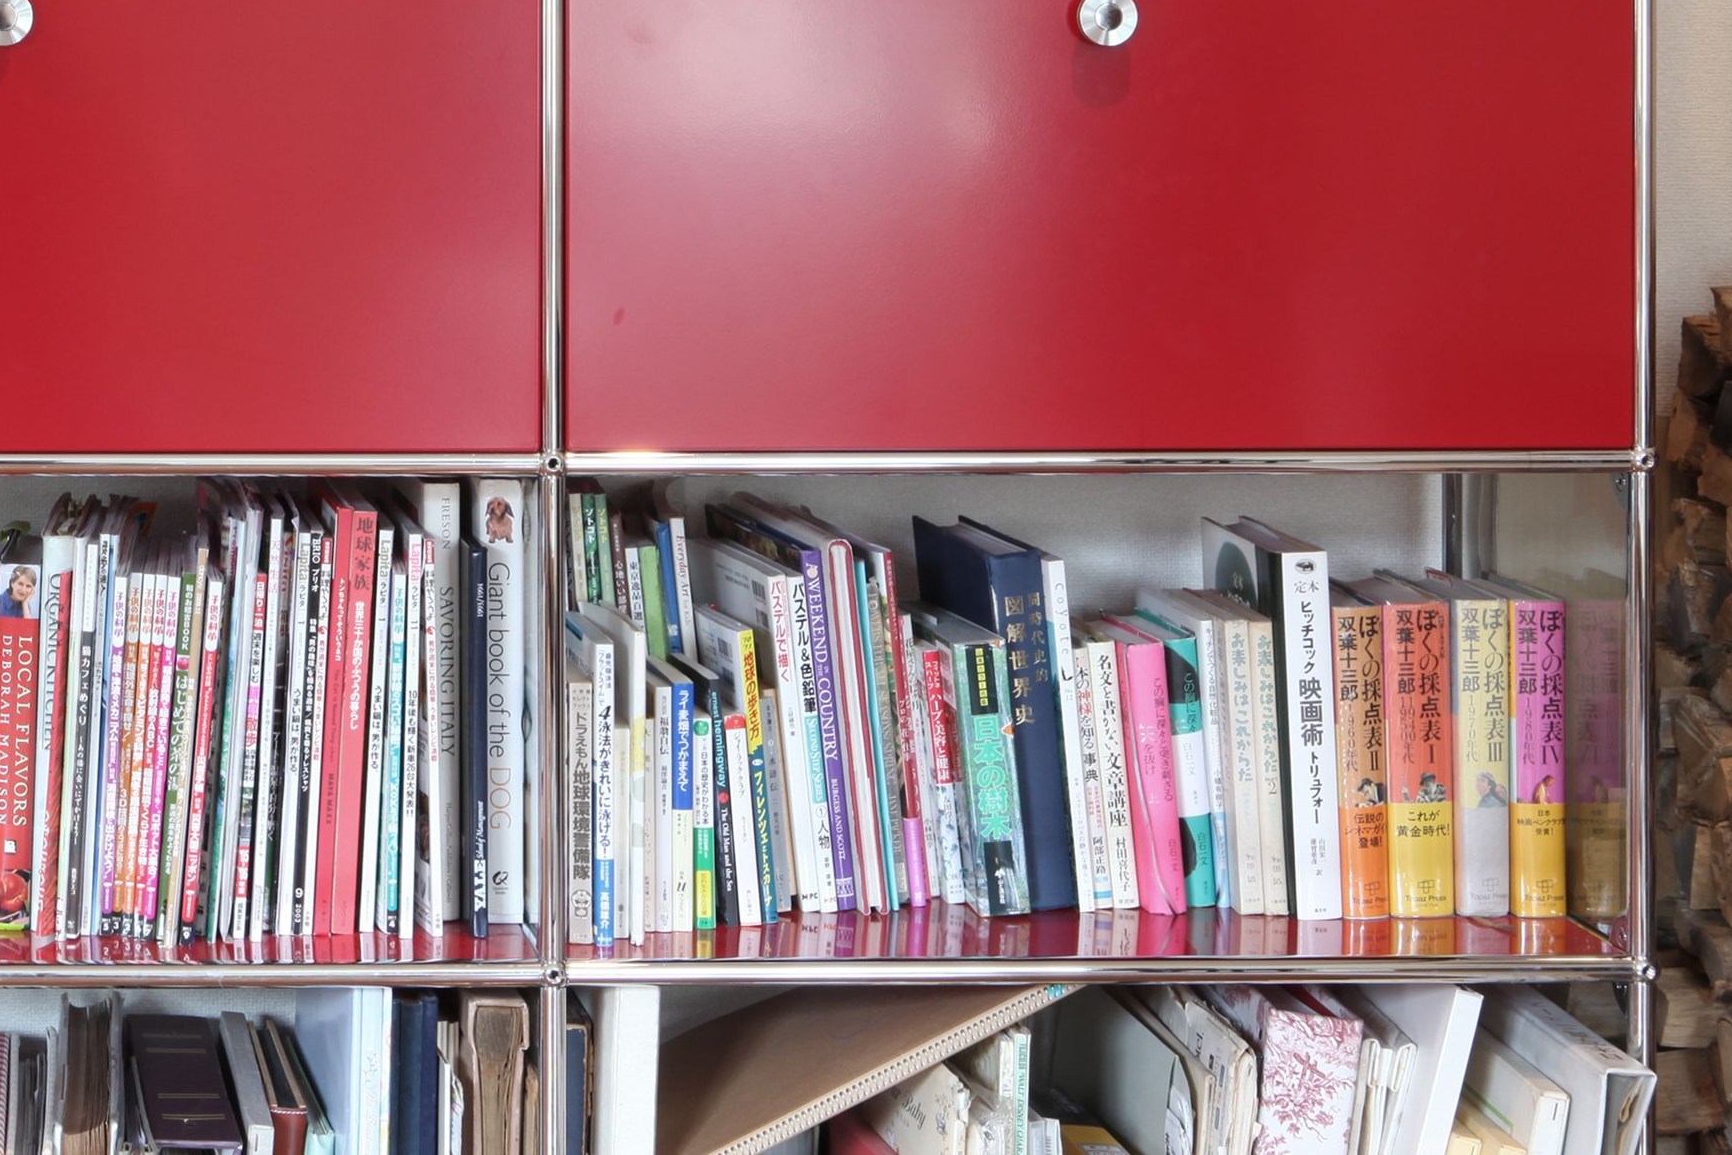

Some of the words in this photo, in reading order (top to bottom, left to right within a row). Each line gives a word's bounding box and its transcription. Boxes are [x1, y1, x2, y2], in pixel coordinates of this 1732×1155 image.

[311, 538, 321, 564] BRIO
[353, 516, 374, 591] 地球家族
[442, 497, 451, 550] FRESON
[310, 568, 320, 593] ブリオ
[379, 539, 391, 578] Lapita
[409, 542, 420, 581] Lapita
[488, 562, 511, 614] Giant
[1294, 579, 1320, 595] 定本
[114, 592, 124, 637] 子供の科学
[129, 588, 140, 634] 子供の科学
[142, 588, 152, 634] 子供の科学
[154, 589, 165, 635] 子供の科学
[166, 592, 177, 637] 子供の科学
[208, 595, 218, 640] 子供の科学
[439, 586, 455, 687] SAVORING
[771, 580, 790, 684] パステルで描く
[1028, 592, 1049, 683] 同時代史的
[488, 620, 511, 675] book
[792, 583, 817, 714] パステル&色鉛筆
[1005, 596, 1036, 726] 図解世界史
[1338, 615, 1359, 702] 双葉十三郎
[1396, 609, 1416, 695] 双葉十三郎
[1461, 608, 1480, 692] 双葉十三郎
[1518, 609, 1538, 695] 双葉十三郎
[0, 634, 14, 725] DEBORAH
[15, 636, 33, 724] LOCAL
[77, 646, 91, 727] 猫カフェめぐり
[489, 680, 511, 703] of
[711, 692, 719, 719] ernest
[743, 650, 761, 742] 地球の歩き方
[441, 691, 456, 757] ITALY
[489, 707, 511, 758] the
[677, 691, 690, 792] ライ麦畑でつかまえて
[713, 720, 726, 787] hemingway
[1097, 654, 1128, 828] 名文を書かない文章講座
[12, 733, 29, 827] FLAVORS
[489, 766, 511, 831] DOG
[700, 750, 709, 825] 日本の歴史がわかる本
[974, 716, 1012, 839] 日本の樹木
[1353, 812, 1384, 825] 伝説の
[1396, 824, 1450, 837] 黄金時代!
[1407, 810, 1441, 822] これが
[1537, 809, 1551, 817] 日本
[1405, 894, 1423, 904] Topaz
[1424, 894, 1447, 903] Press
